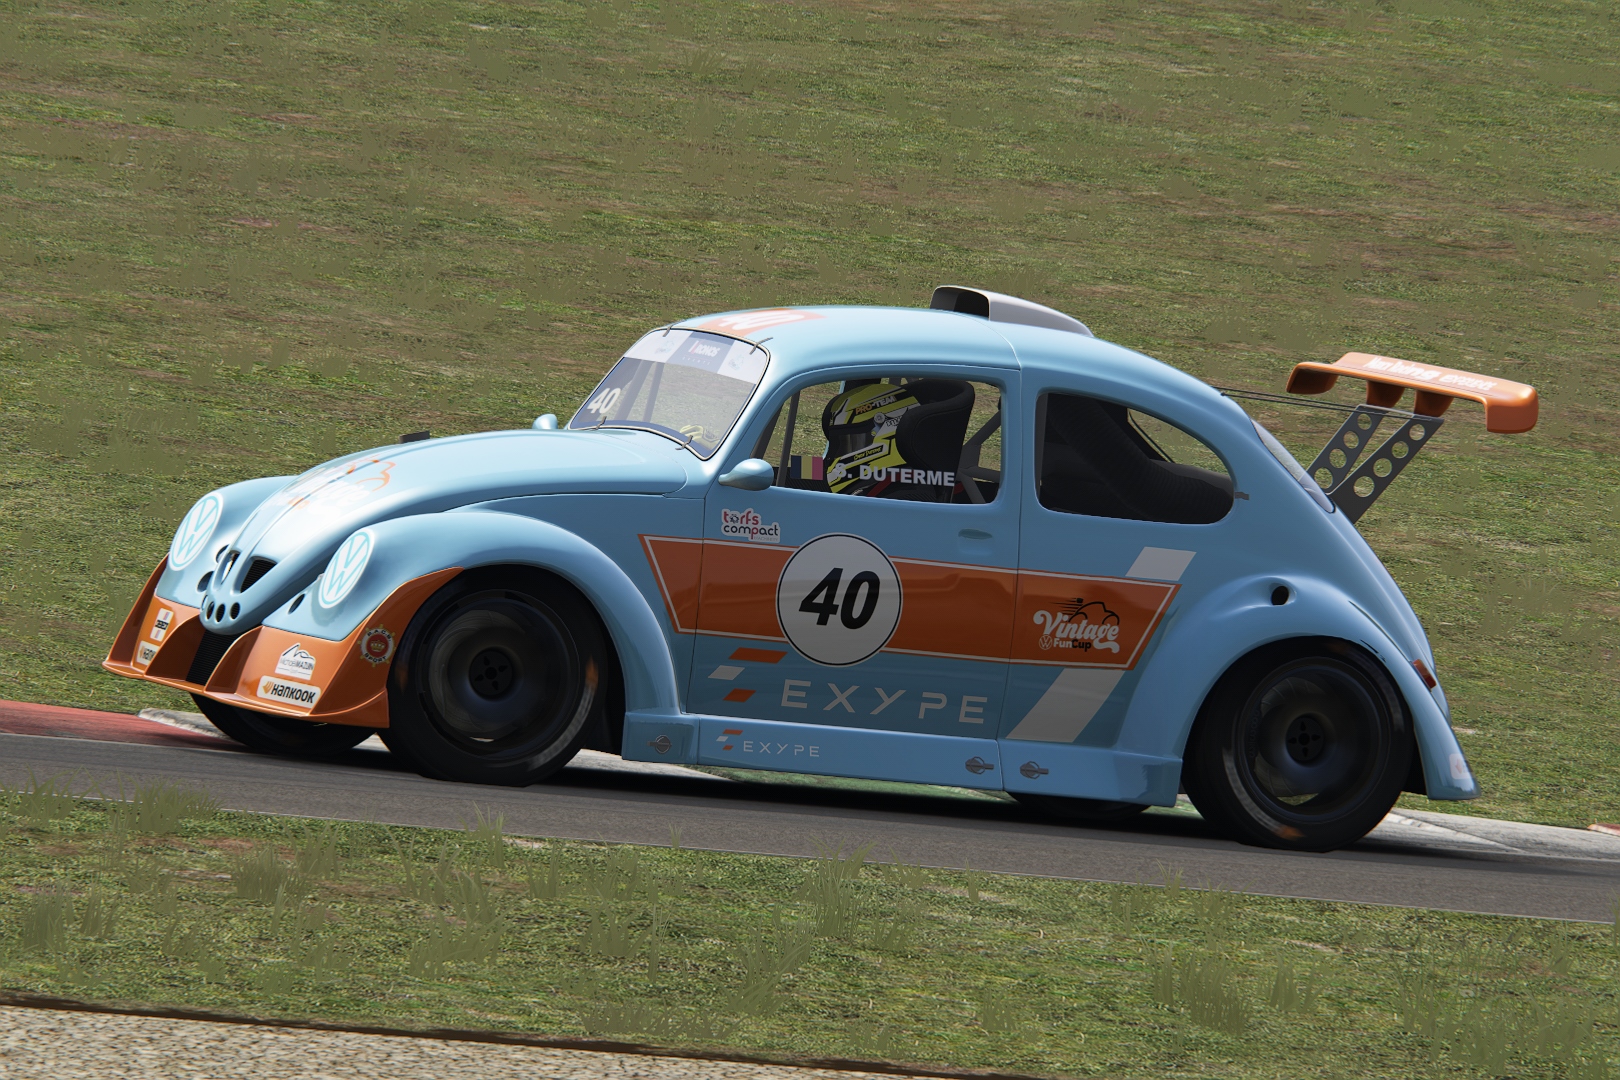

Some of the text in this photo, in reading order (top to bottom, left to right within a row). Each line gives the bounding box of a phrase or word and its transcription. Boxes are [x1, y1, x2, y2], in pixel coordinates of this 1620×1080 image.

[587, 387, 621, 413] 40
[859, 464, 955, 487] DUTERME
[723, 524, 779, 540] compact
[798, 567, 881, 630] 40
[1033, 610, 1120, 654] Vintage
[780, 678, 988, 724] EXYPE
[743, 740, 820, 758] EXYPE
